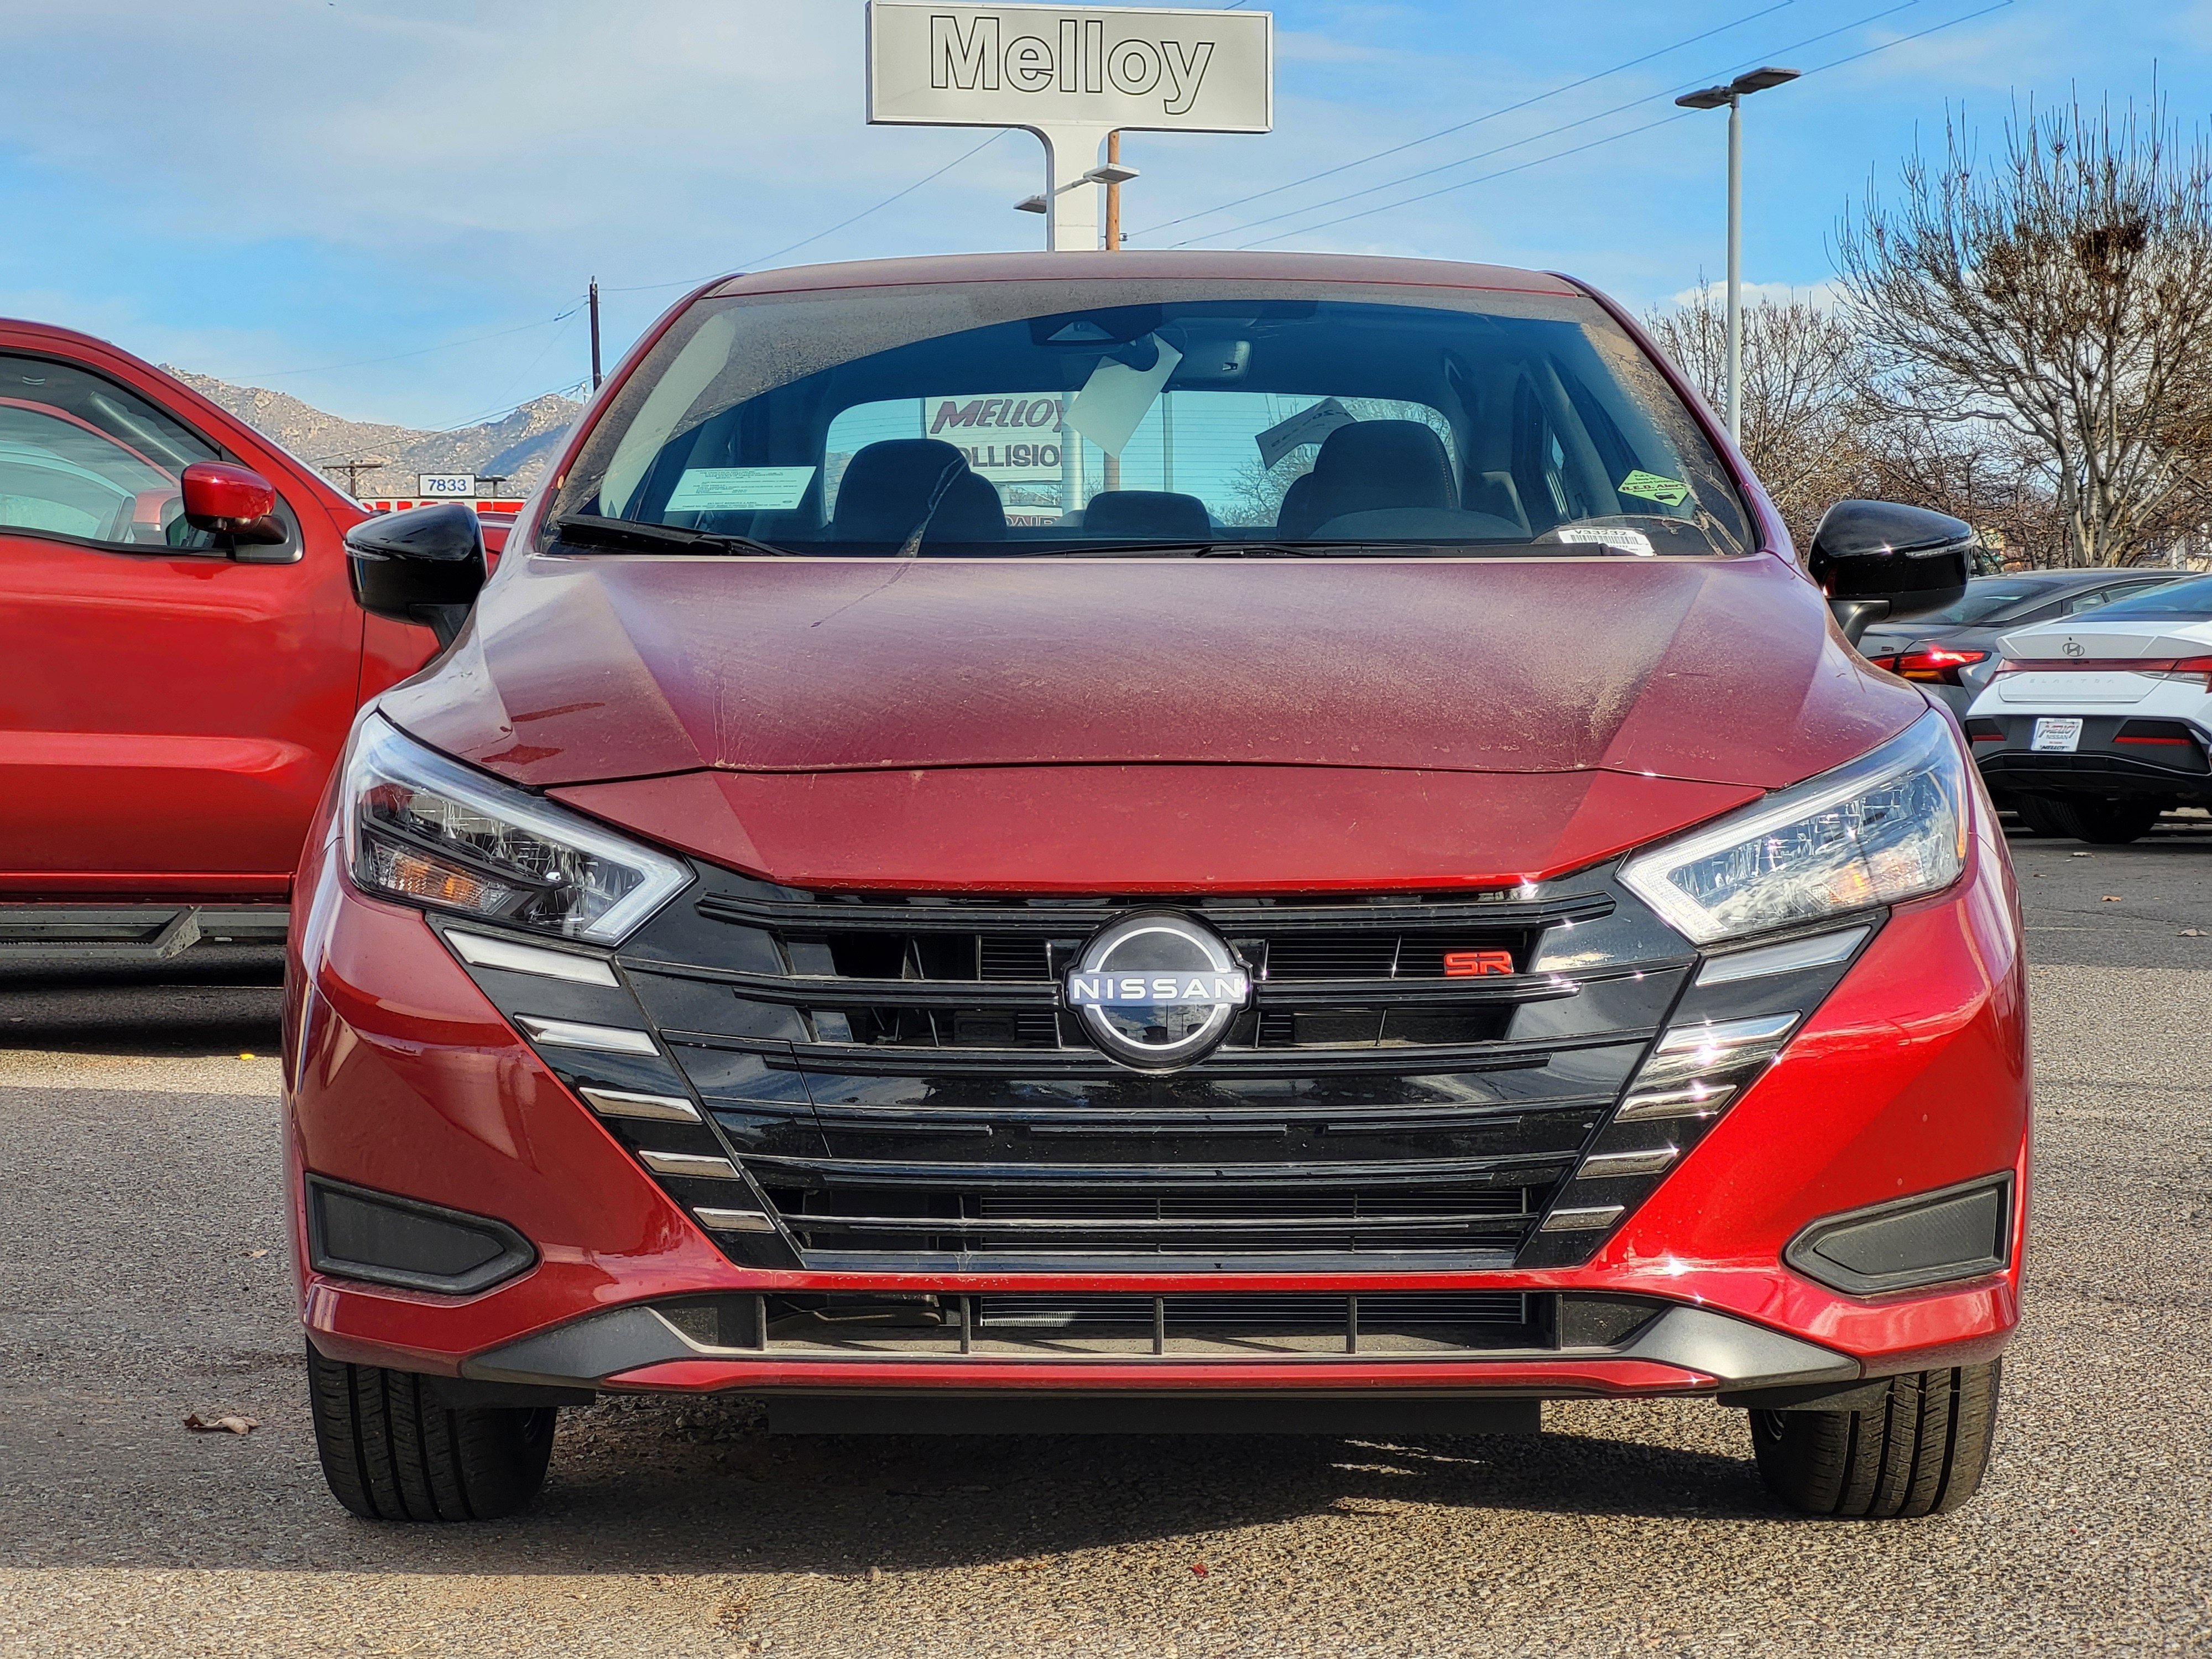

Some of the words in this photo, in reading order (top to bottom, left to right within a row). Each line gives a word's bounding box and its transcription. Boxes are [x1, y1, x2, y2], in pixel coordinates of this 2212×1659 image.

[930, 15, 1215, 114] Melloy
[958, 444, 1062, 467] LLISIO
[427, 479, 467, 491] 7833
[1446, 951, 1514, 976] SR
[1073, 978, 1241, 999] NISSAN
